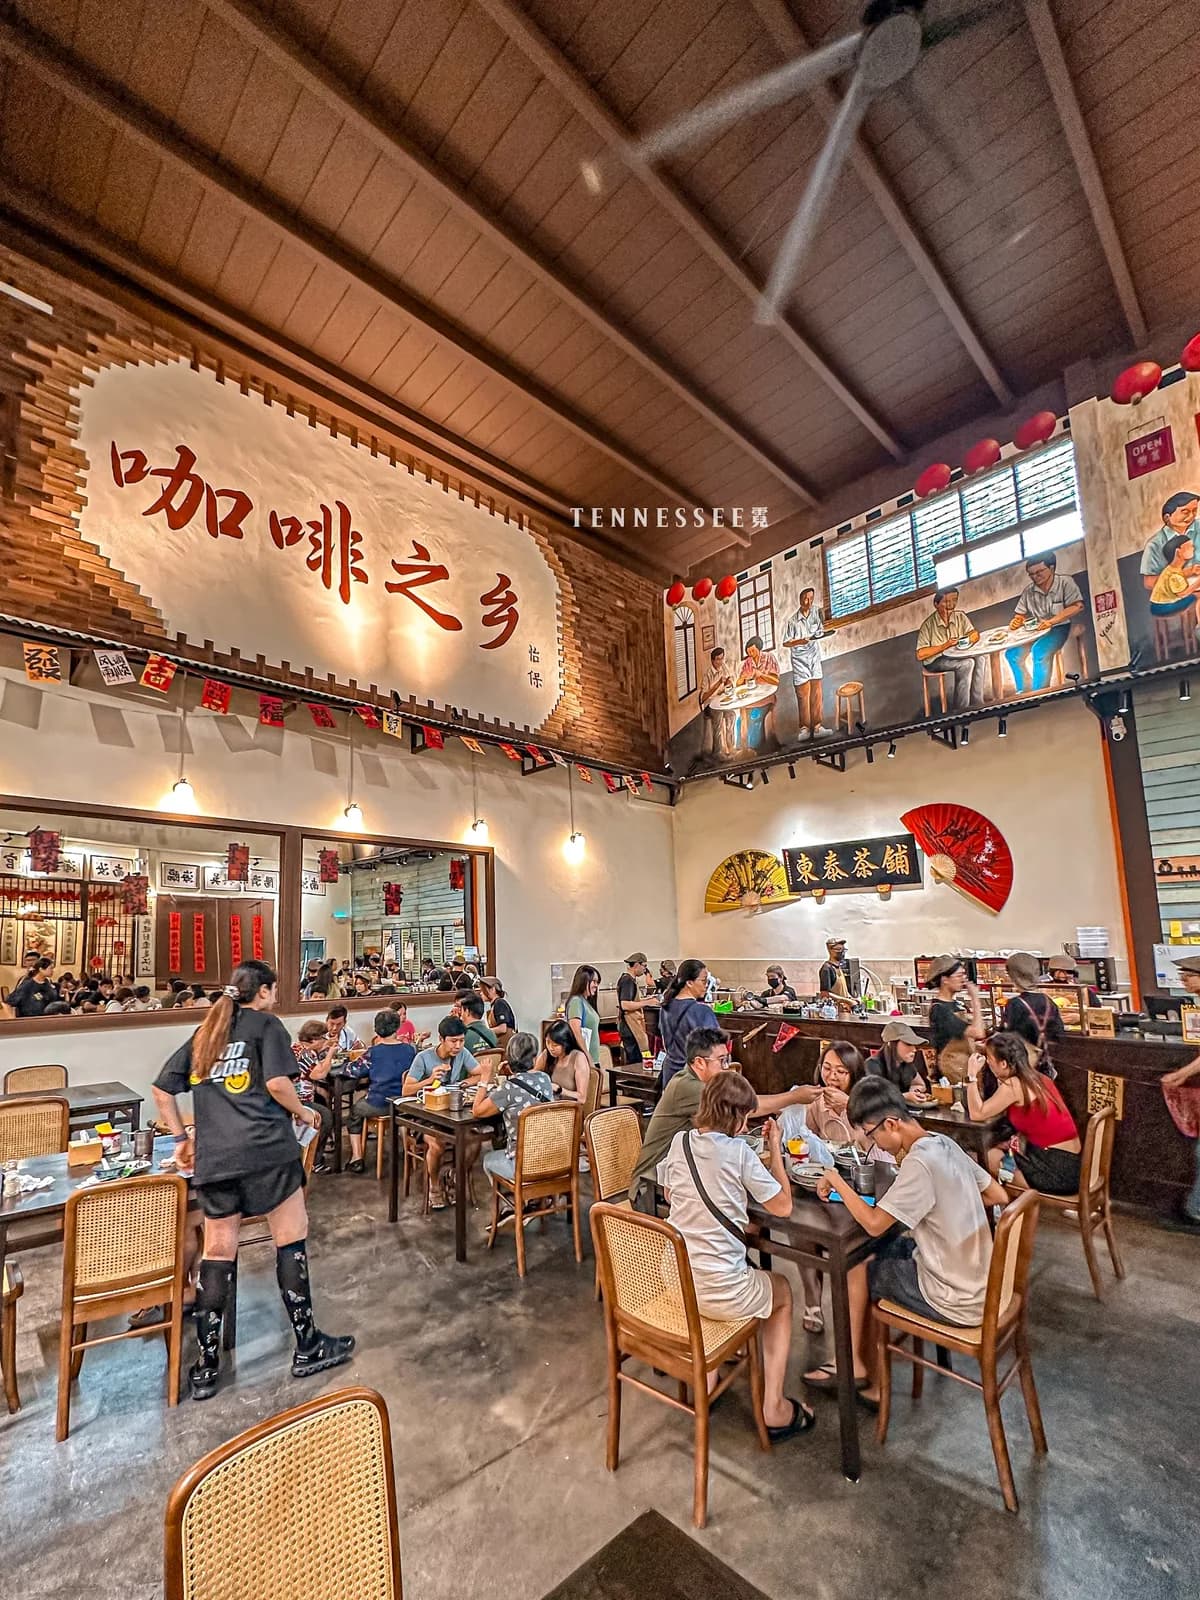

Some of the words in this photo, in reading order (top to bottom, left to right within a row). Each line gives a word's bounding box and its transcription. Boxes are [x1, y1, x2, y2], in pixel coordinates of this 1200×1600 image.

[1132, 437, 1162, 456] OPEN
[111, 440, 520, 649] 咖啡之乡
[527, 643, 543, 688] 怡保
